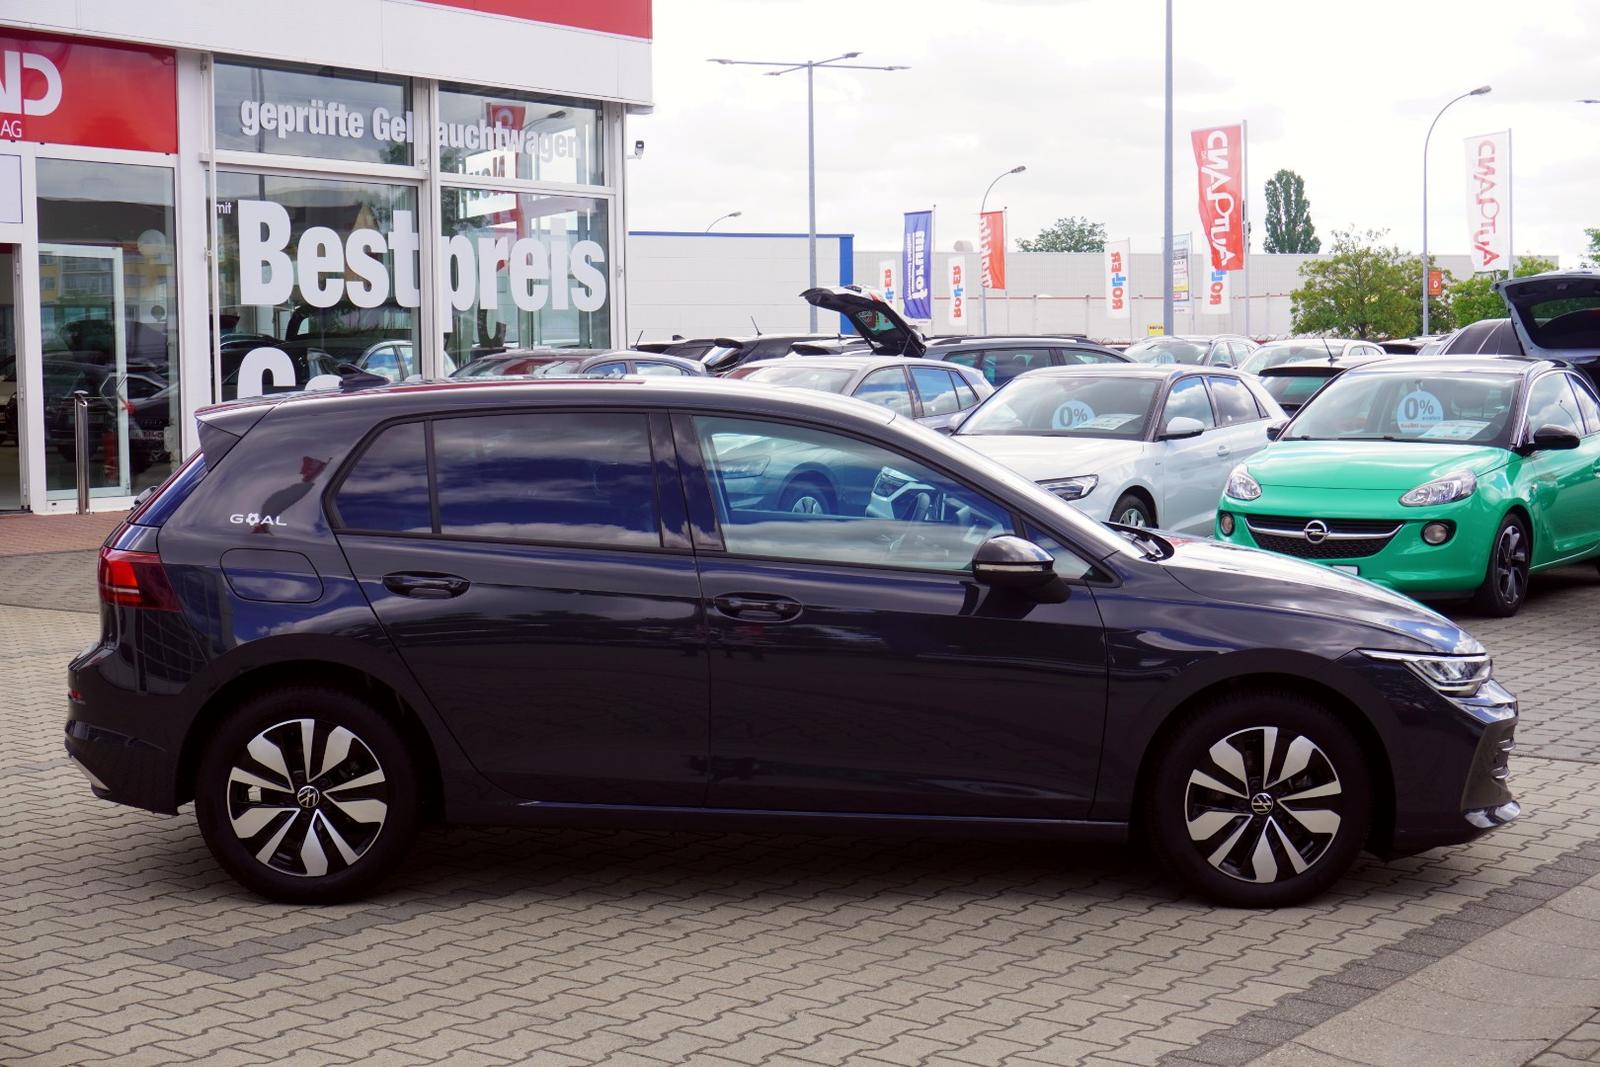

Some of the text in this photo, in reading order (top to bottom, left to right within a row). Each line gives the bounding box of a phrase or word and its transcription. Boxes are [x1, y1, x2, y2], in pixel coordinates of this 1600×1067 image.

[0, 120, 22, 137] AG
[240, 99, 365, 139] geprüfte
[1060, 406, 1088, 427] 0%
[1404, 397, 1434, 420] 0%
